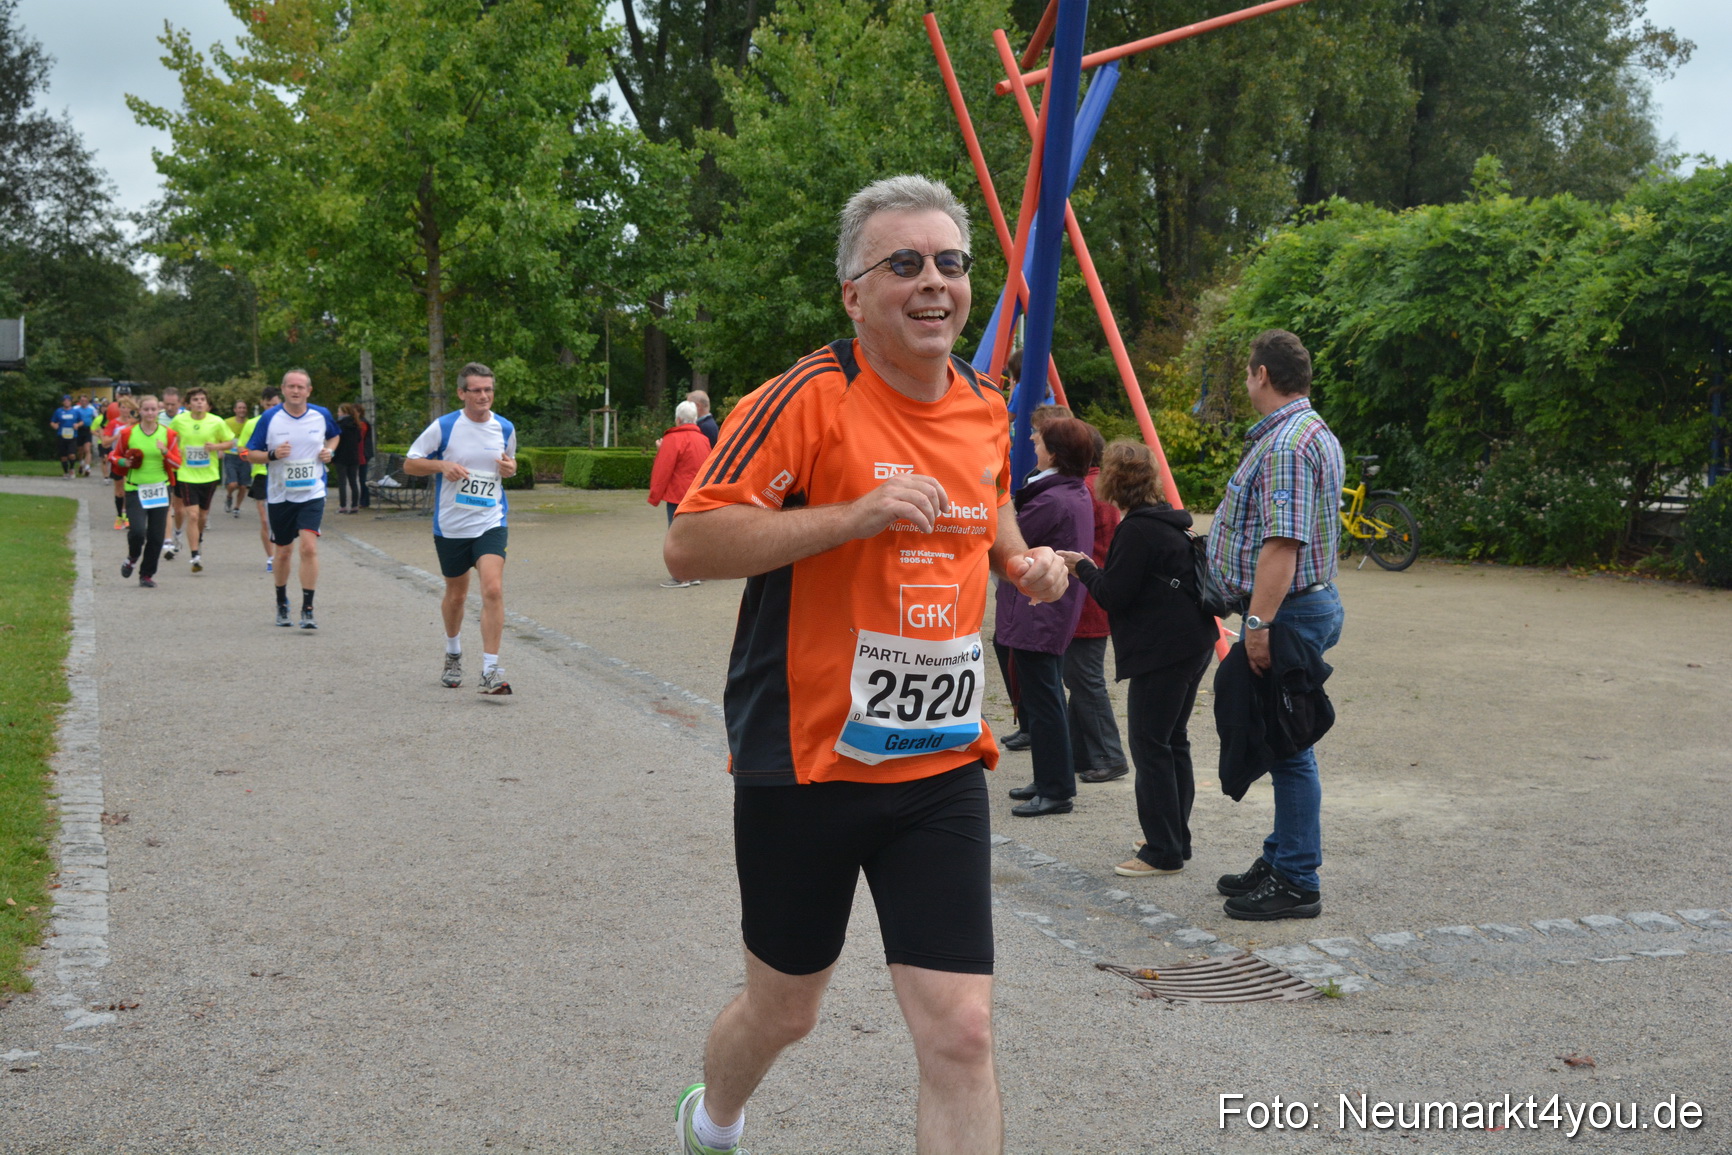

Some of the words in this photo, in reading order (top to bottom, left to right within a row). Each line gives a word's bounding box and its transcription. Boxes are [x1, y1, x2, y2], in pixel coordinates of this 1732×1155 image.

[187, 450, 209, 460] 2755
[287, 466, 314, 479] 2887
[141, 488, 164, 499] 3347
[461, 478, 495, 496] 2672
[935, 524, 970, 535] Stadtlauf
[971, 526, 987, 535] 2009
[918, 550, 955, 560] Katzwang
[907, 603, 952, 628] GfK
[859, 644, 910, 665] PARTL
[914, 651, 969, 667] Neumarkt
[866, 669, 976, 722] 2520
[884, 734, 945, 751] Gerald
